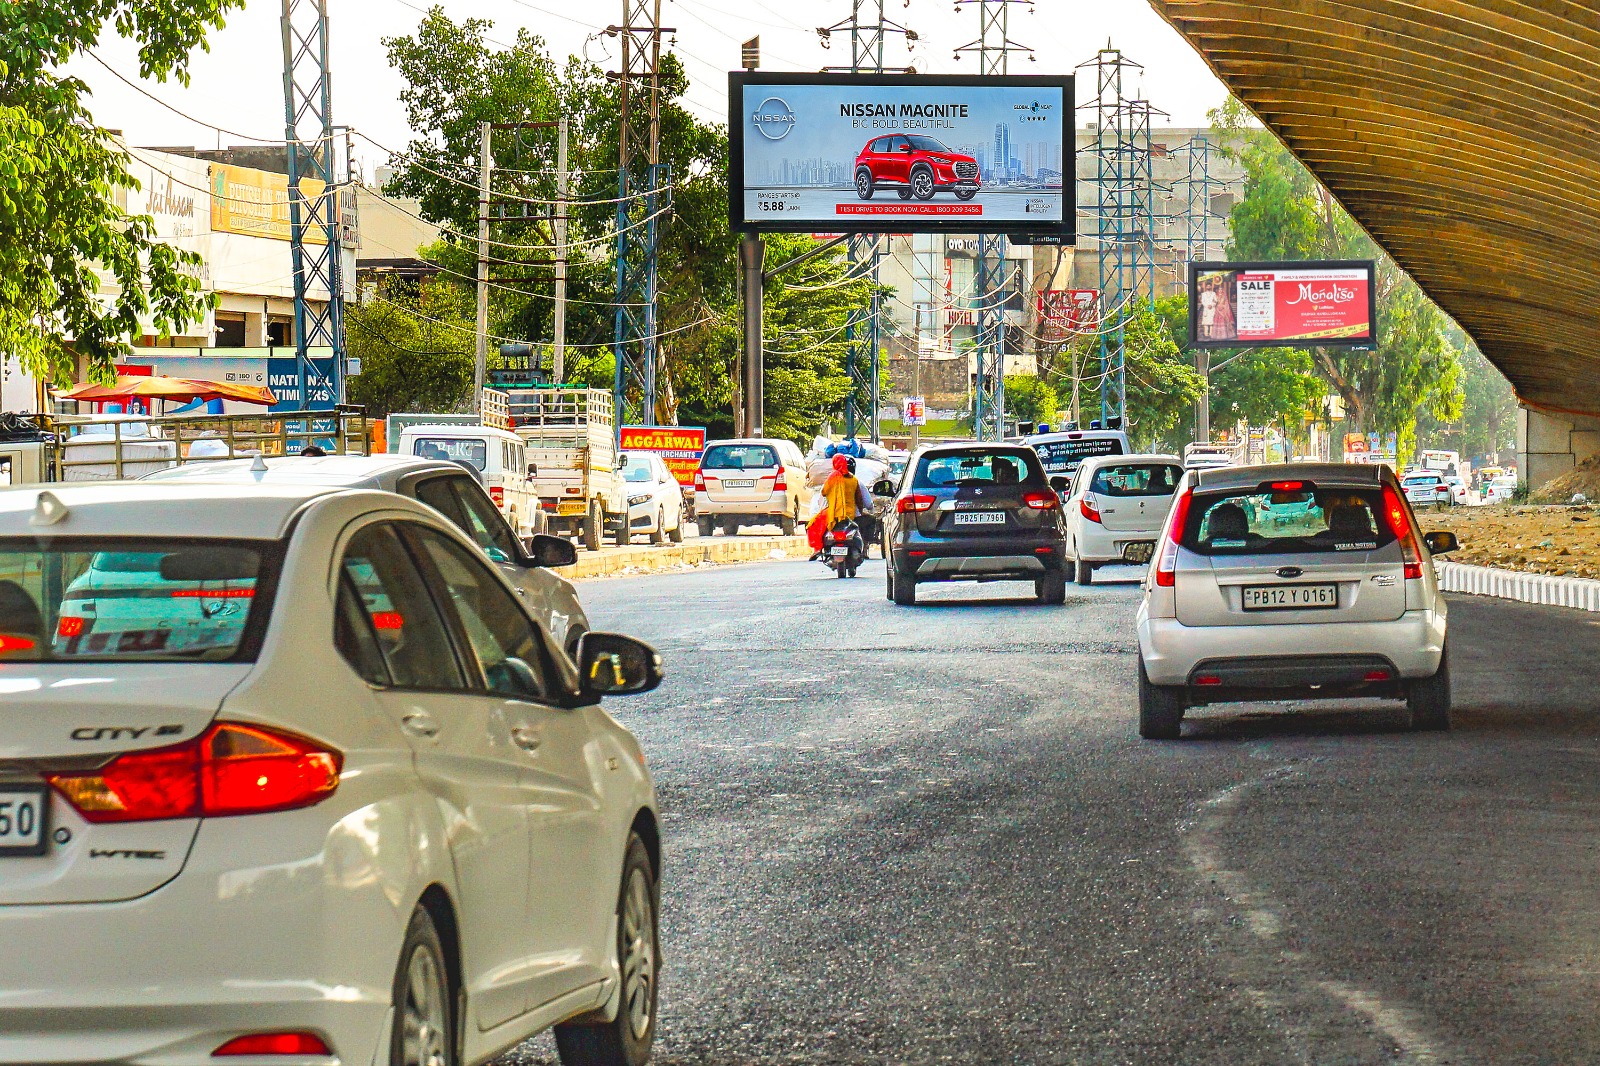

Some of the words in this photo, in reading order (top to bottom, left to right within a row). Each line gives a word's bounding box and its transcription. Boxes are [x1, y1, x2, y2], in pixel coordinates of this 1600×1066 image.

[840, 104, 896, 117] NISSAN
[900, 104, 969, 118] MAGNITE
[872, 119, 900, 129] BOLD.
[948, 239, 964, 250] OYO
[1241, 281, 1271, 291] SALE
[623, 435, 702, 449] AGGARWAL
[960, 514, 978, 522] PB25
[1253, 590, 1286, 605] PB12
[1291, 590, 1298, 603] Y
[1303, 588, 1335, 603] 0161
[70, 726, 150, 741] CITY
